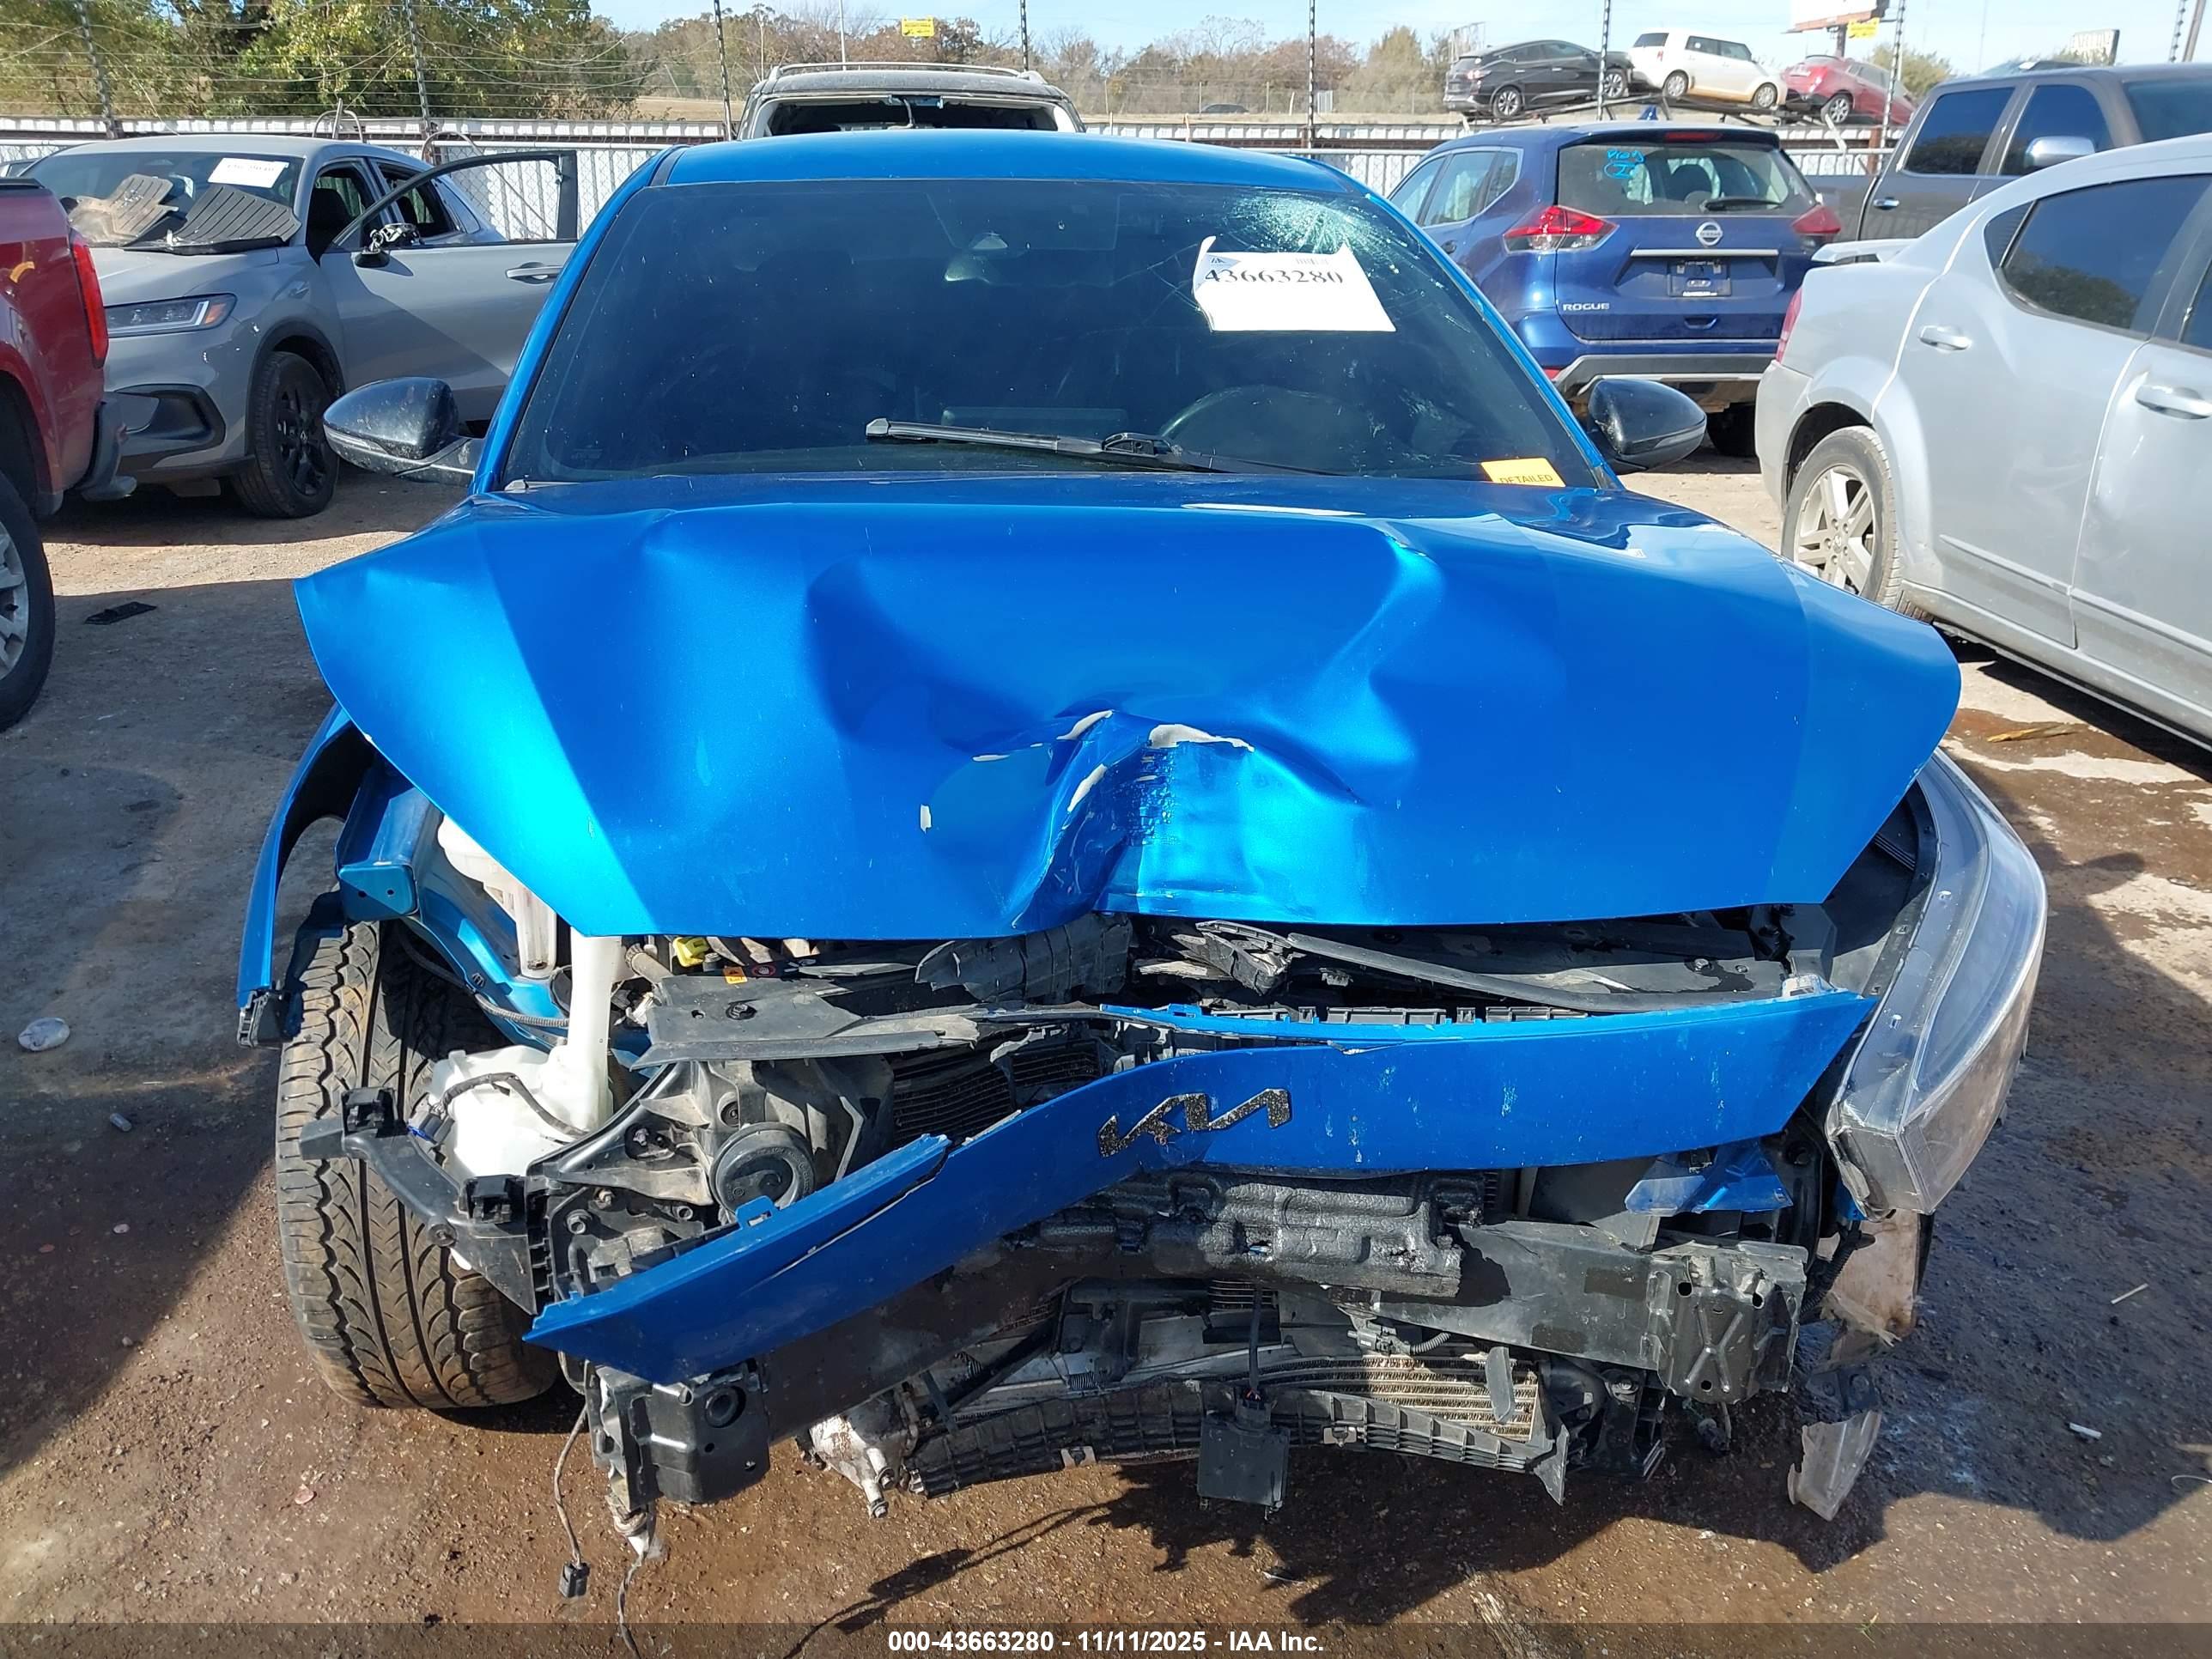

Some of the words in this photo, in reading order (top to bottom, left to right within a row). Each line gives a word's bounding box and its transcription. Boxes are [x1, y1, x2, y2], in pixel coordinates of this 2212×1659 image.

[1206, 269, 1343, 283] 43663280
[1563, 302, 1610, 311] ROGUE
[1097, 1087, 1292, 1158] KIA
